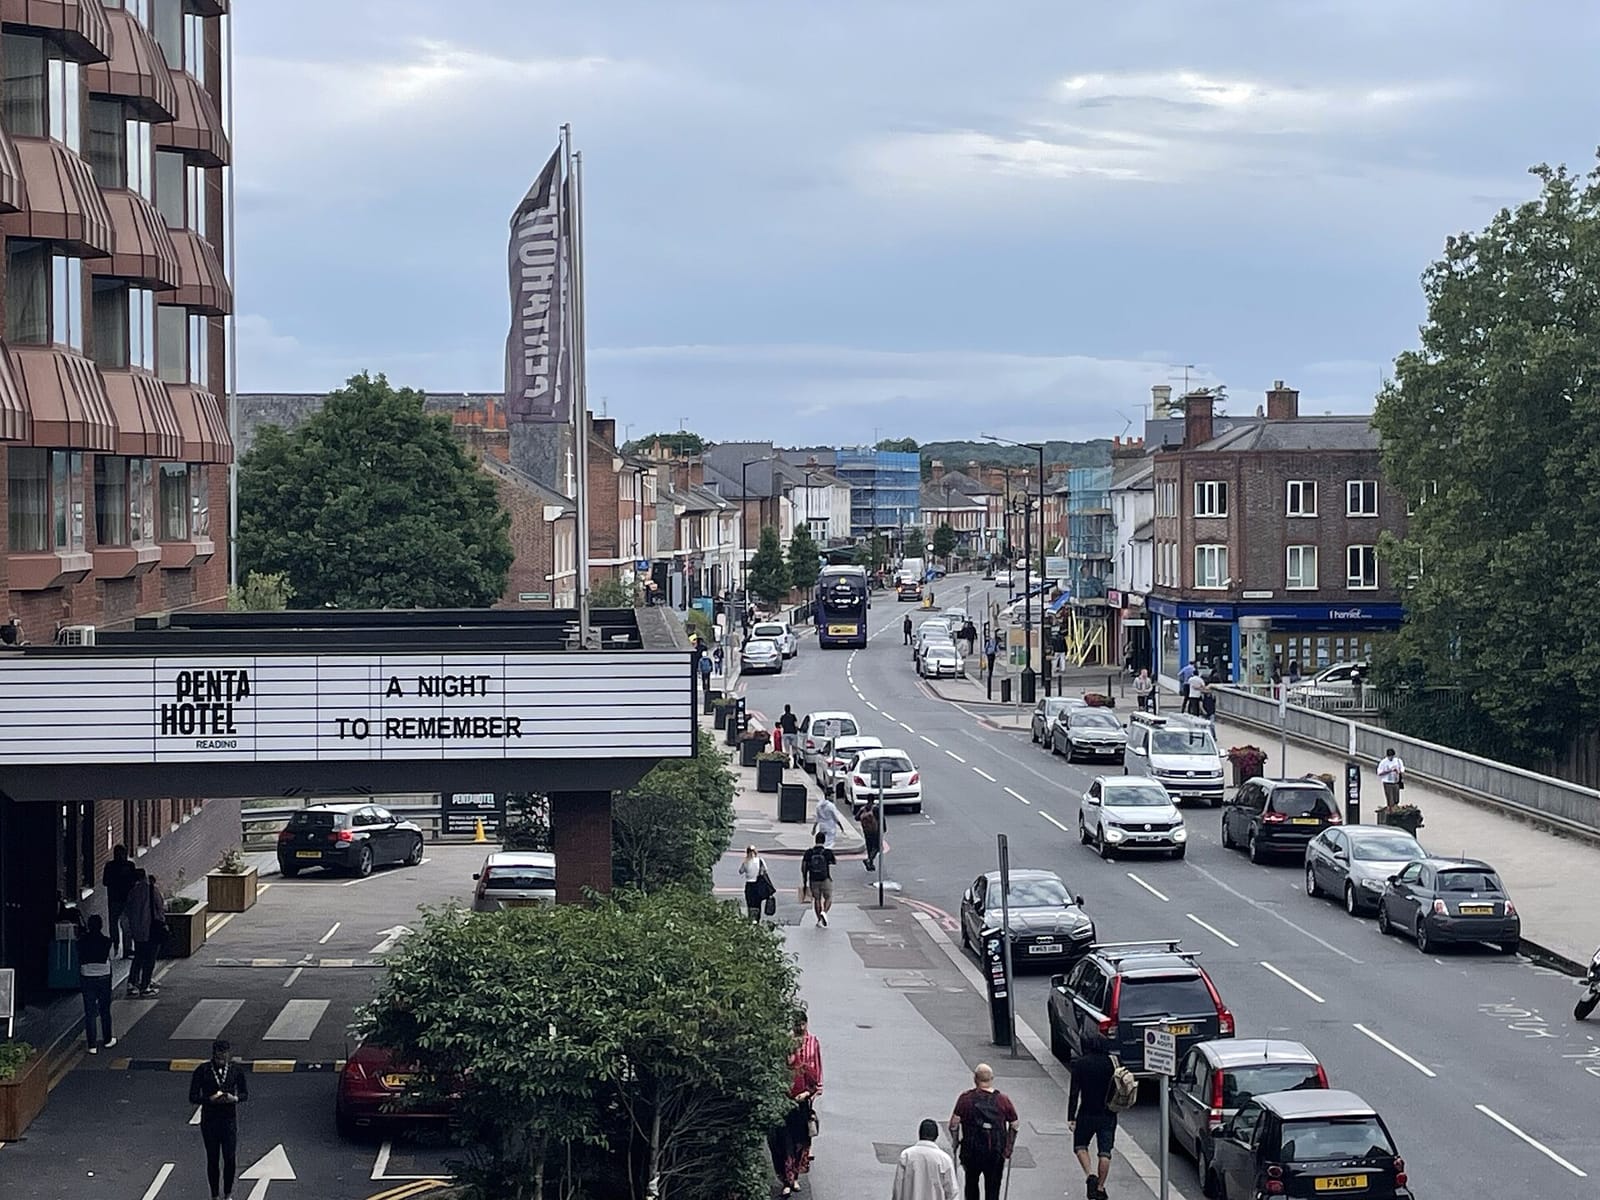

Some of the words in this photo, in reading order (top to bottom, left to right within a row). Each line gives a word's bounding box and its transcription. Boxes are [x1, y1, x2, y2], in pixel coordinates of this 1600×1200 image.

[176, 670, 250, 703] PENTA
[386, 676, 403, 698] A
[418, 675, 490, 698] NIGHT
[161, 703, 237, 735] HOTEL
[335, 718, 369, 740] TO
[386, 716, 522, 739] REMEMBER
[196, 740, 237, 749] READING
